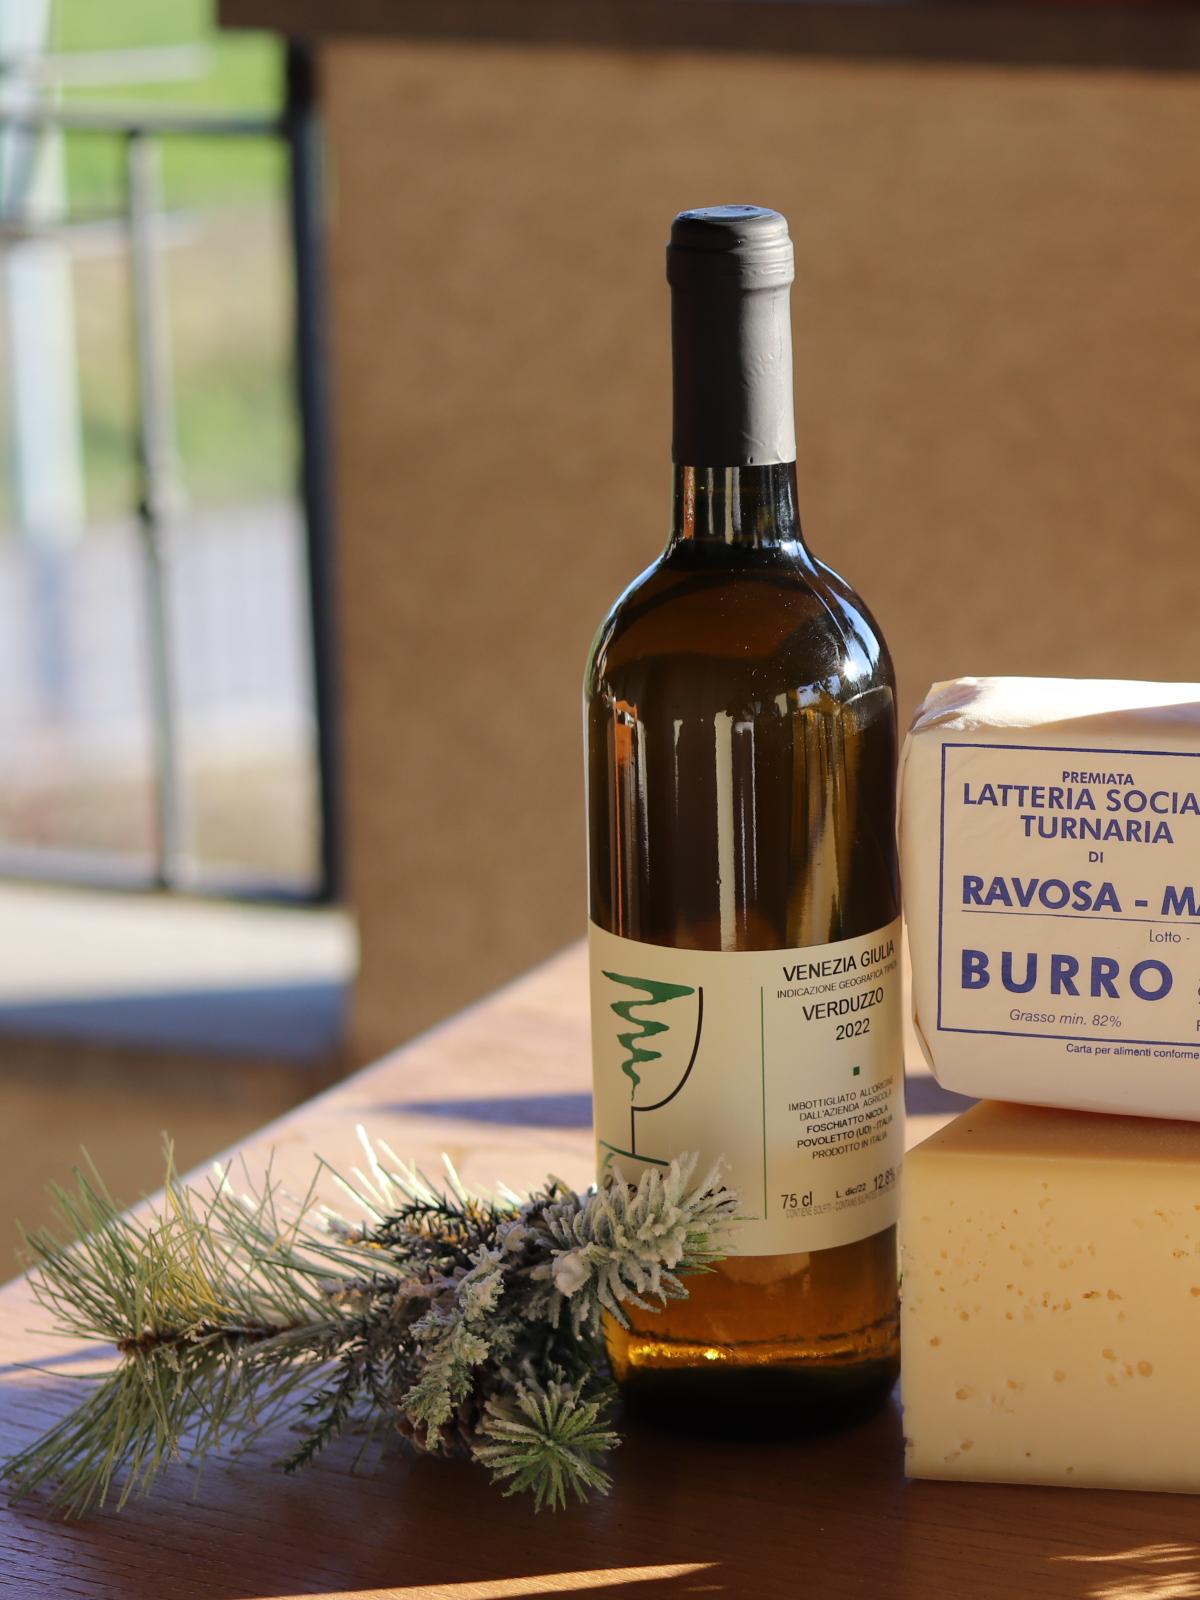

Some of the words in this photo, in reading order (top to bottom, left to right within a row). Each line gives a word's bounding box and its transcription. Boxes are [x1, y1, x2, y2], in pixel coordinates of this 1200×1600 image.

[1062, 771, 1135, 786] PREMIATA
[963, 783, 1097, 811] LATTERIA
[1020, 815, 1174, 844] TURNARIA
[1088, 851, 1104, 864] DI
[961, 875, 1122, 913] RAVOSA
[1149, 929, 1182, 945] Lotto
[782, 955, 857, 982] VENEZIA
[860, 939, 895, 967] GIULIA
[777, 983, 837, 999] INDICAZIONE
[838, 970, 883, 990] GEOGRAFICA
[961, 949, 1173, 1001] BURRO
[802, 987, 884, 1021] VERDUZZO
[836, 1018, 870, 1040] 2022
[1009, 1008, 1056, 1024] Grasso
[1059, 1013, 1087, 1026] min.
[1092, 1014, 1122, 1029] 82%
[1066, 1043, 1092, 1055] Carta
[1095, 1046, 1111, 1057] per
[1113, 1046, 1151, 1058] alimenti
[1153, 1048, 1200, 1061] conforme
[788, 1091, 857, 1112] IMBOTTIGLIATO
[800, 1102, 860, 1122] DALL'AZIENDA
[806, 1114, 864, 1134] FOSCHIATTO
[865, 1105, 889, 1121] NICOLA
[797, 1130, 854, 1149] POVOLETTO
[856, 1124, 872, 1139] (UD)
[812, 1140, 860, 1160] PRODOTTO
[861, 1138, 869, 1149] IN
[869, 1131, 888, 1146] ITALIA
[781, 1193, 798, 1209] 75
[802, 1191, 813, 1207] cl
[836, 1190, 842, 1199] L
